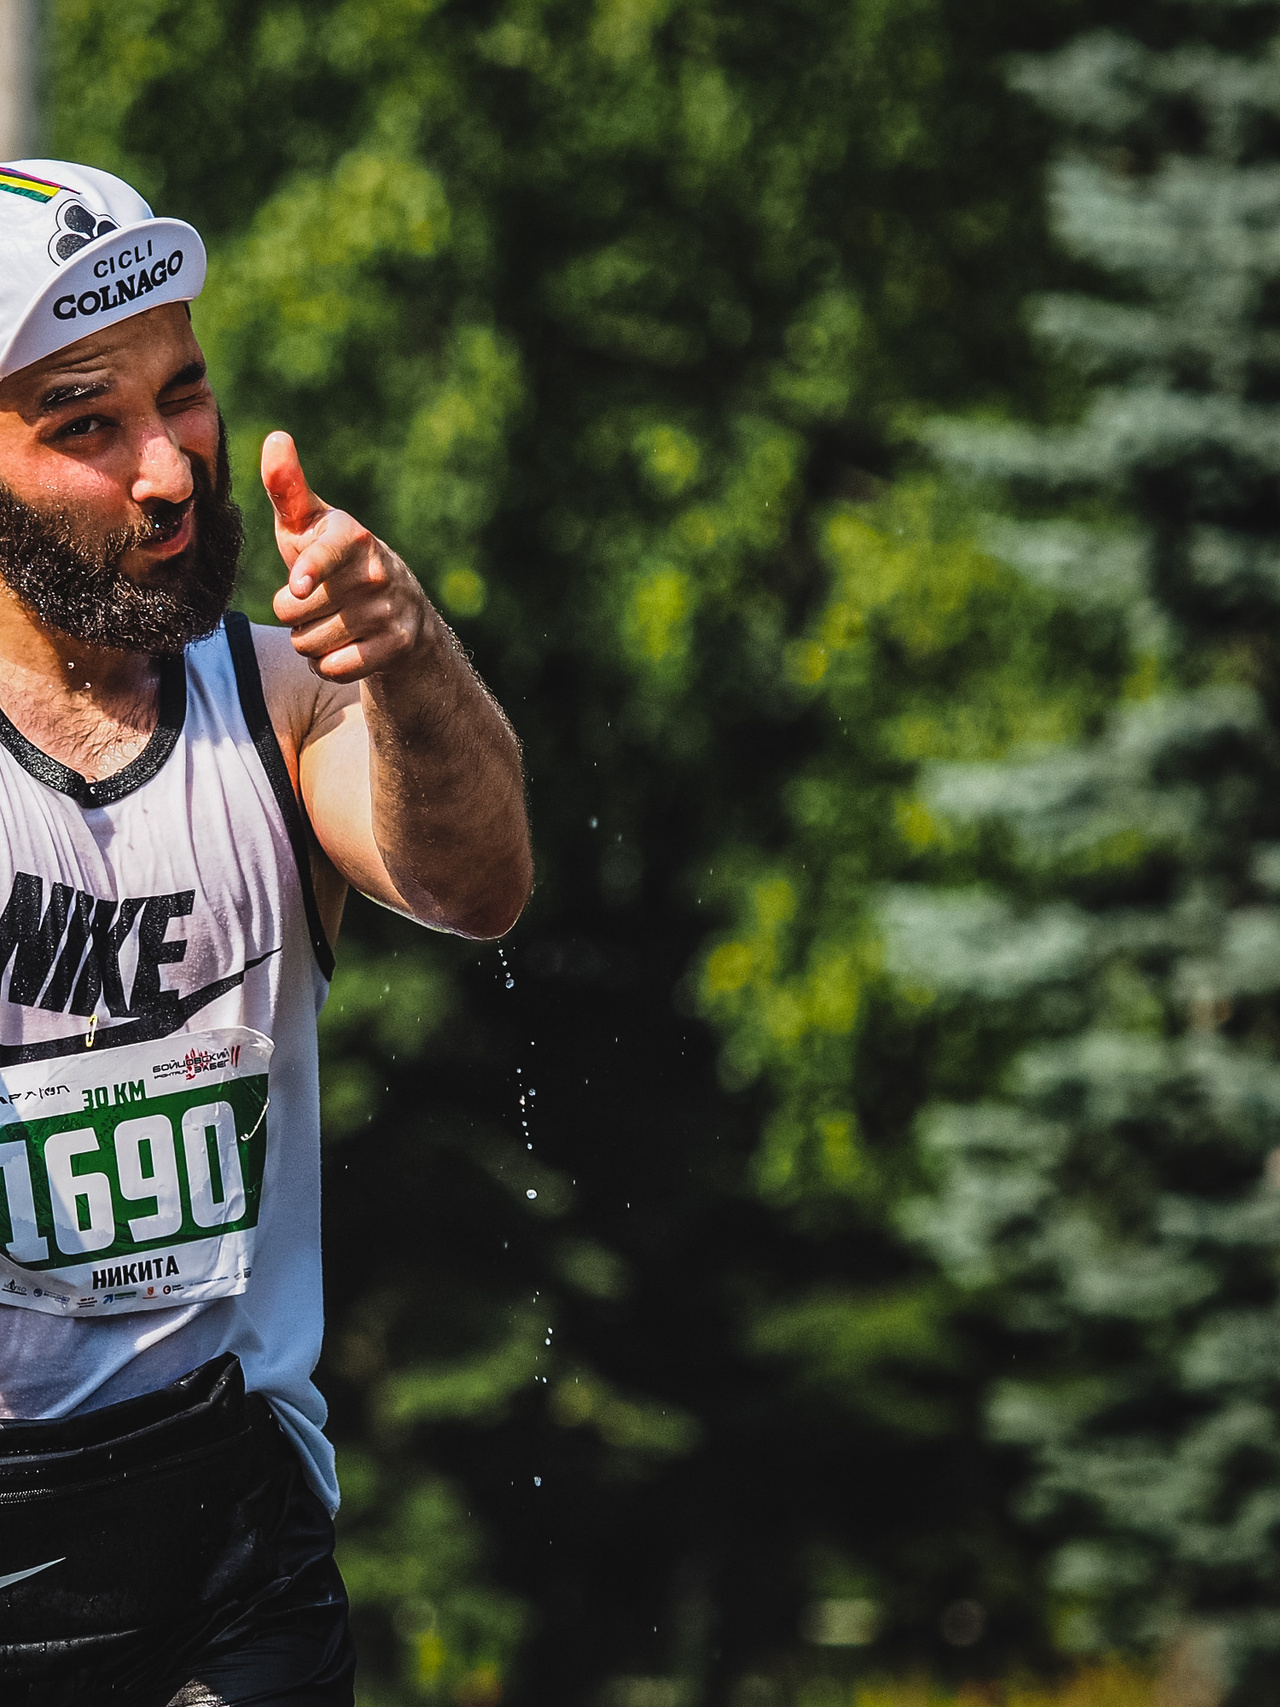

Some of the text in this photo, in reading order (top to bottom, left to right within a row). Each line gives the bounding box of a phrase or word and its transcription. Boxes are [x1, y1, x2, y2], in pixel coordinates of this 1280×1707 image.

[93, 240, 152, 278] CICLI
[53, 250, 183, 320] COLNAGO
[82, 1086, 109, 1109] 30
[92, 1255, 179, 1290] НИКИТА
